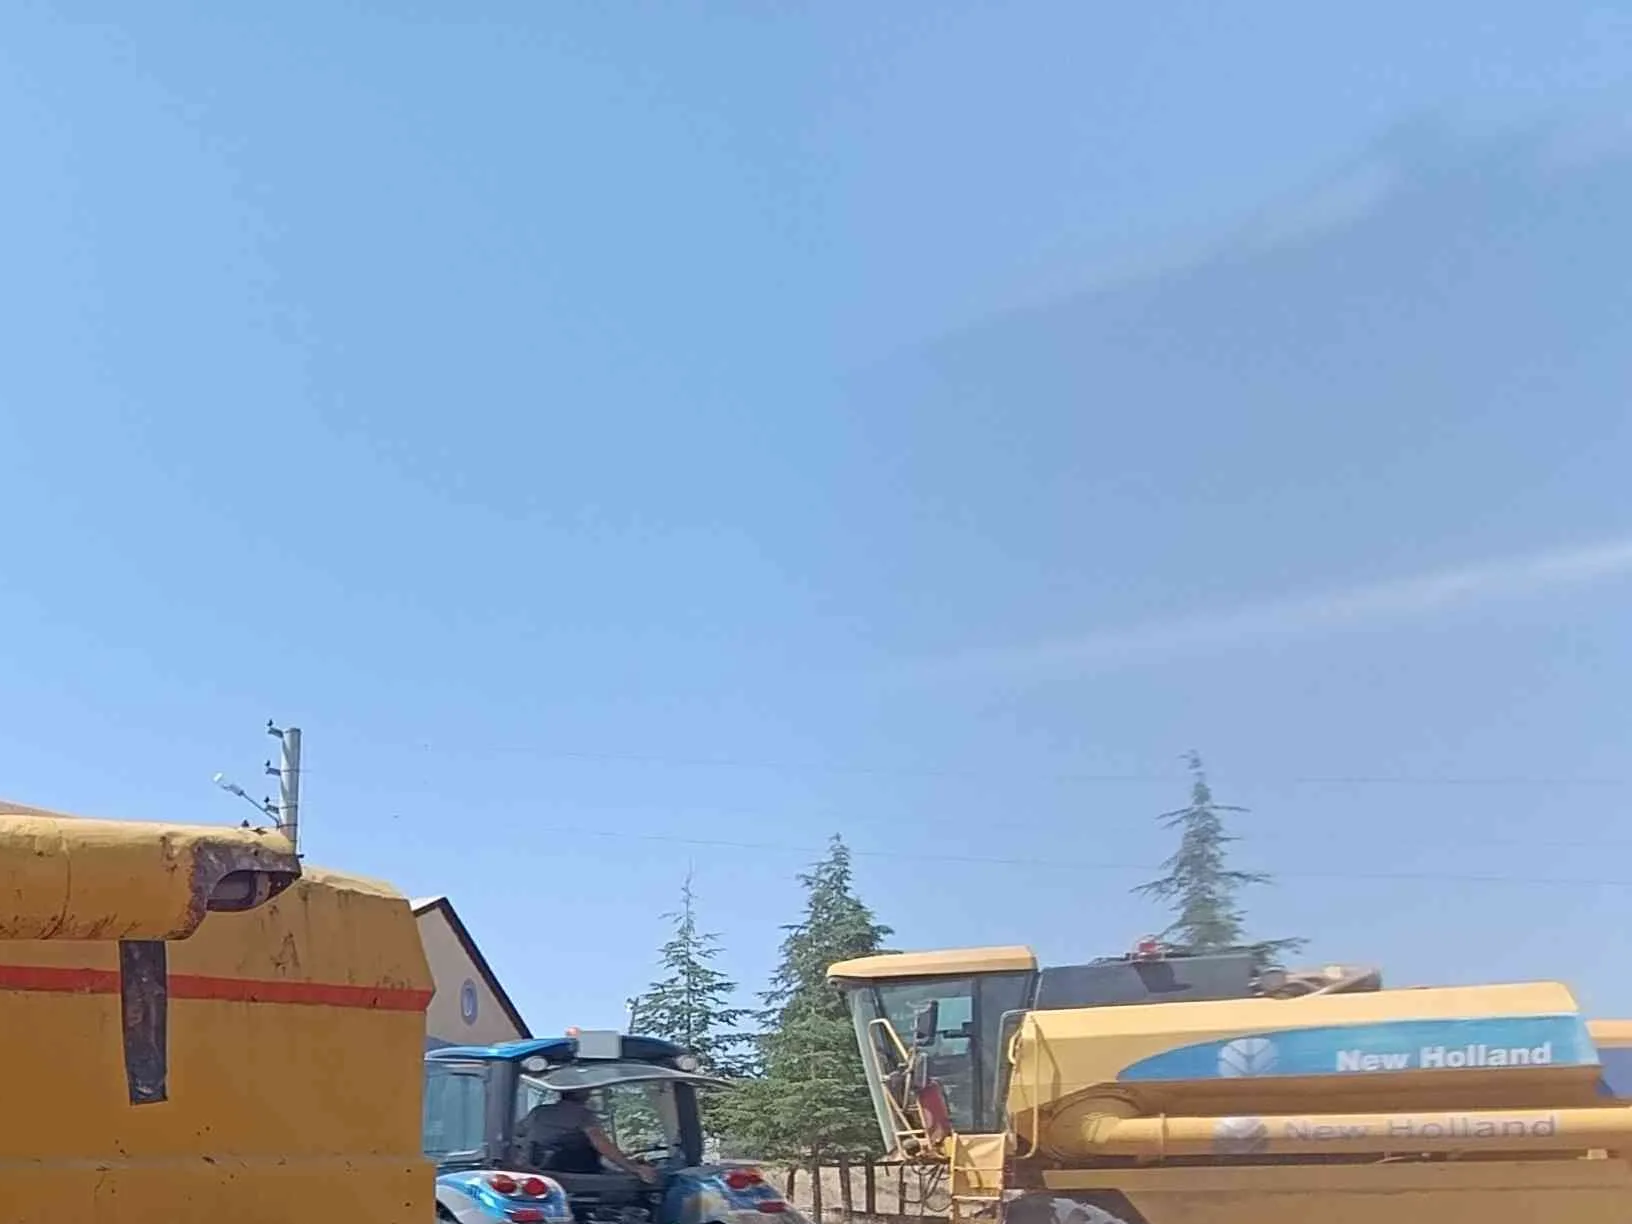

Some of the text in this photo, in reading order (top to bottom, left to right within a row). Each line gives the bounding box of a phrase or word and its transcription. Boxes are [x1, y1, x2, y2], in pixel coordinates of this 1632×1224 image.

[1336, 1042, 1552, 1072] New Holland
[1285, 1115, 1556, 1142] New Holland
